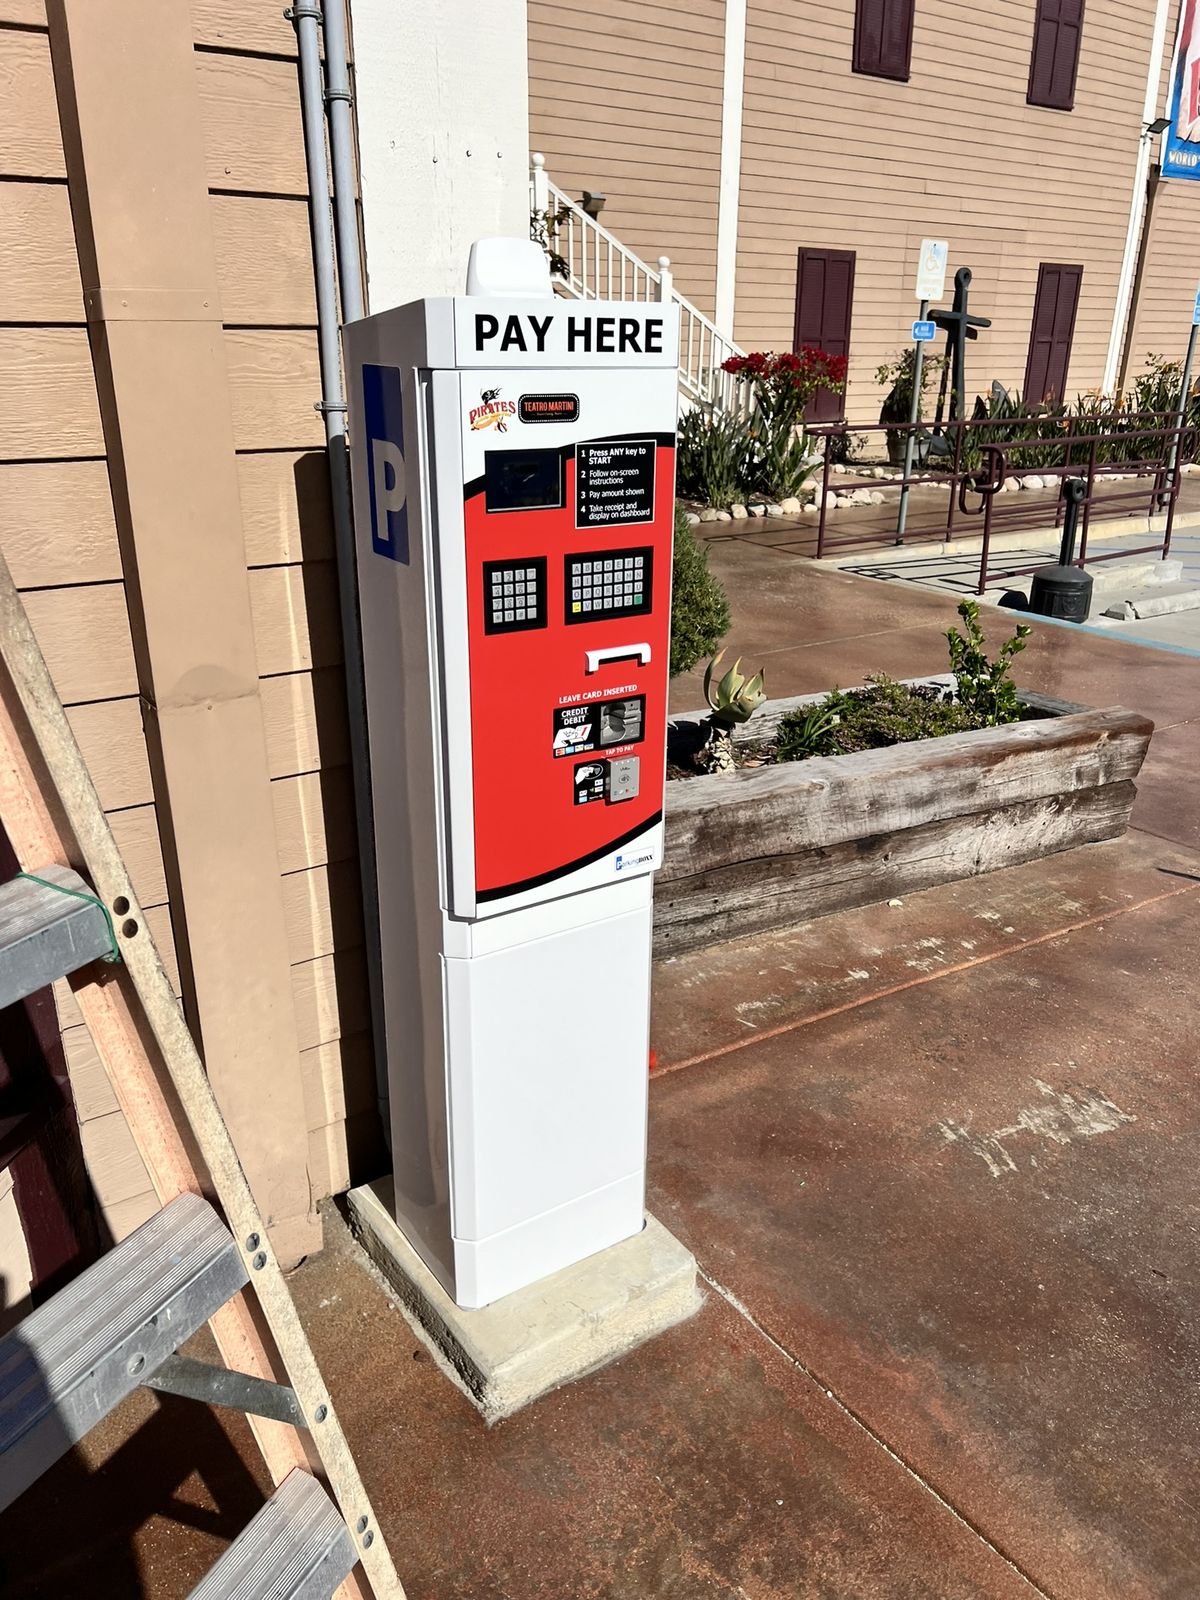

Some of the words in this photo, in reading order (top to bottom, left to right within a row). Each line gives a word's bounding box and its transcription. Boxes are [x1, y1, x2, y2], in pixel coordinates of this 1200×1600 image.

[474, 313, 554, 352] PAY
[567, 316, 664, 353] HERE
[524, 401, 547, 412] TEATRO
[548, 401, 574, 411] MARTINI
[469, 400, 516, 425] PIRATES
[580, 450, 586, 458] 1
[589, 449, 608, 457] Press
[610, 448, 624, 456] ANY
[625, 447, 638, 456] key
[588, 456, 612, 465] START
[589, 470, 609, 478] Follow
[589, 477, 624, 486] instructions
[372, 438, 407, 541] P
[589, 490, 600, 499] Pay
[601, 489, 624, 498] amount
[625, 488, 645, 496] shown
[604, 503, 624, 511] receipt
[626, 501, 637, 510] and
[588, 512, 610, 521] display
[620, 508, 650, 518] dashboard
[559, 694, 581, 704] LEAVE
[582, 690, 602, 700] CARD
[604, 684, 638, 696] INSERTED
[561, 707, 589, 718] CREDIT
[564, 715, 586, 726] DEBIT
